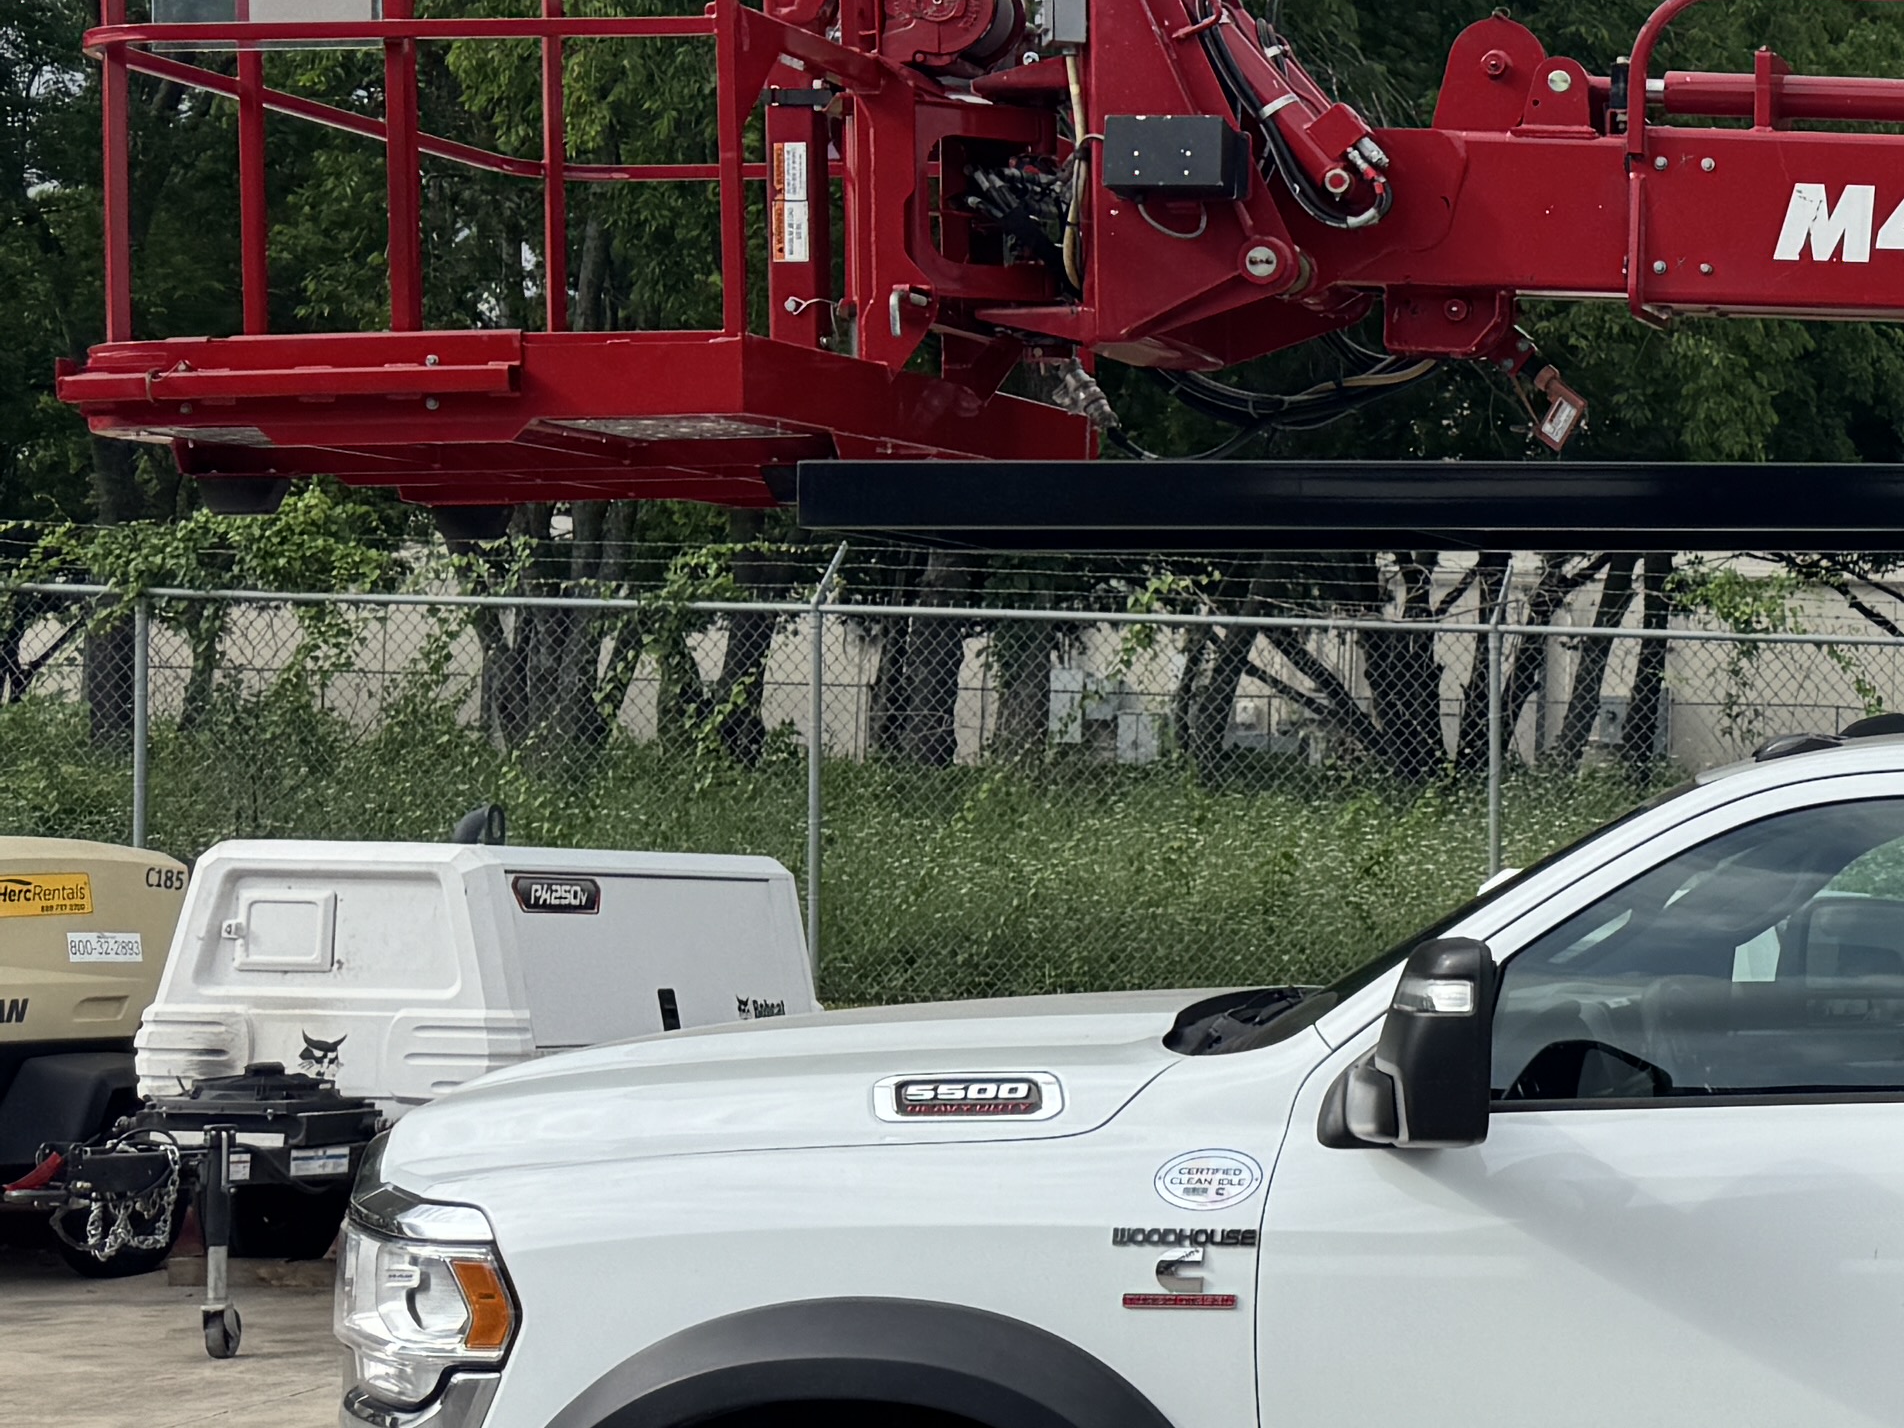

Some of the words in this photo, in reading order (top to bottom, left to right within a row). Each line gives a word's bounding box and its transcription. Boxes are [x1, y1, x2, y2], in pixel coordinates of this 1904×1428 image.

[146, 867, 184, 890] C185
[0, 884, 86, 902] HercRentals
[70, 939, 141, 956] 800-32-2893
[905, 1083, 1029, 1100] 5500
[1178, 1167, 1242, 1176] CERTIFIED
[1170, 1177, 1213, 1186] CLEAN
[1218, 1178, 1246, 1186] IDLE
[1112, 1227, 1257, 1247] WOODHOUSE
